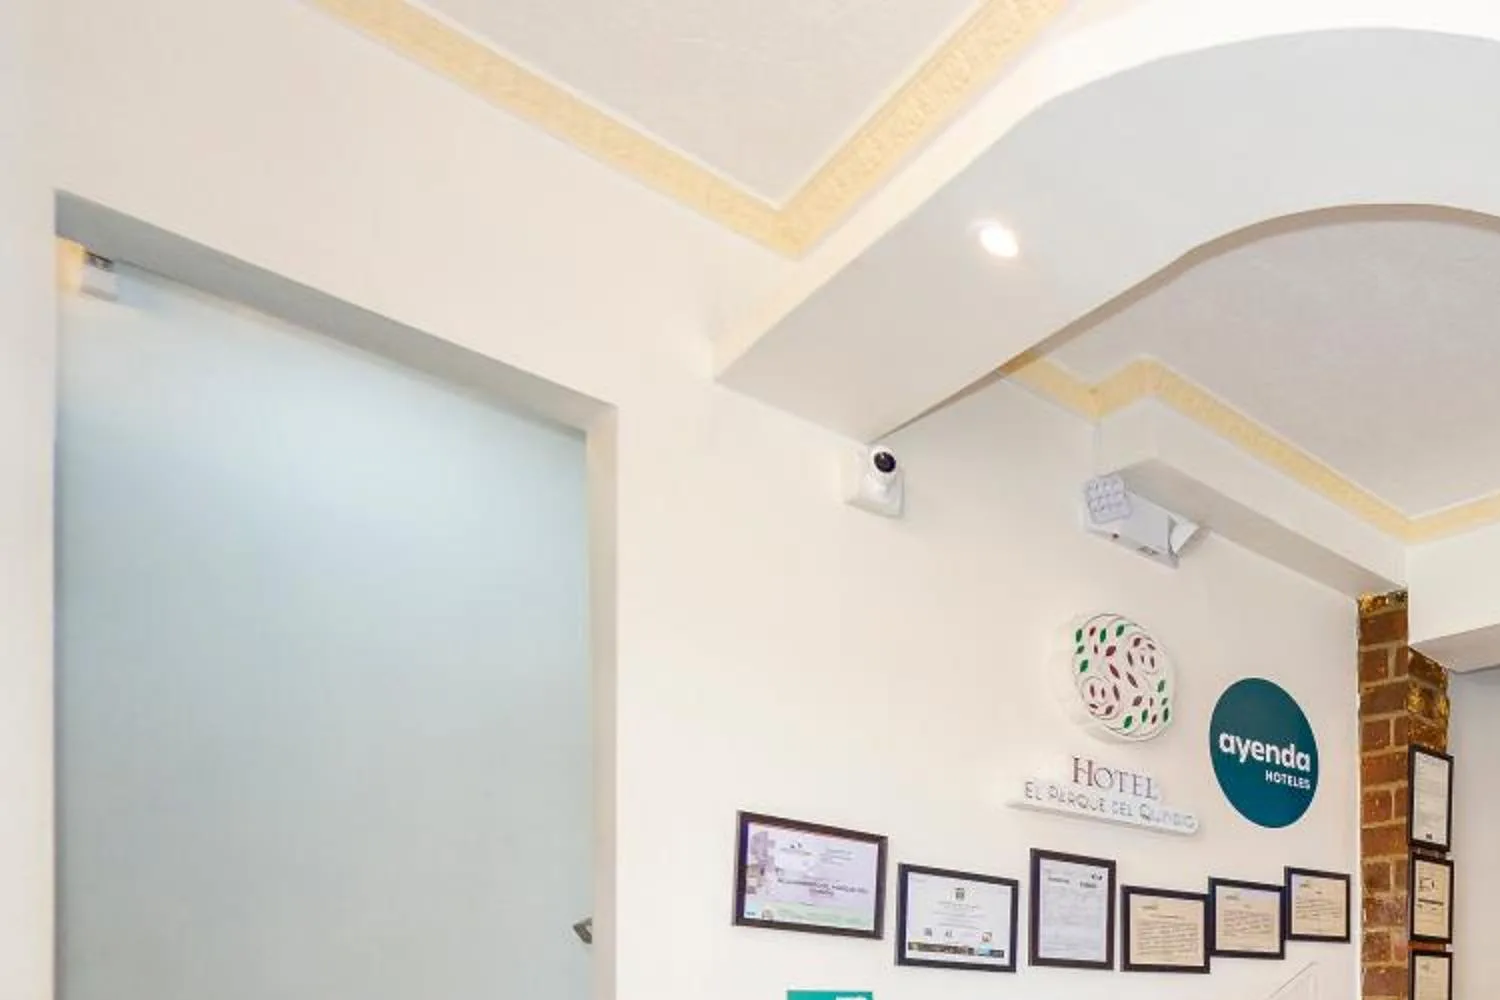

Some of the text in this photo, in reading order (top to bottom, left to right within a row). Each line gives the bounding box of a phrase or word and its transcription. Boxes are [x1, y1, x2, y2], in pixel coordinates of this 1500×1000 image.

[1219, 732, 1311, 772] ayenda
[1024, 780, 1043, 801] EL
[1072, 756, 1160, 801] HOTEL
[1265, 769, 1311, 790] HOTELES
